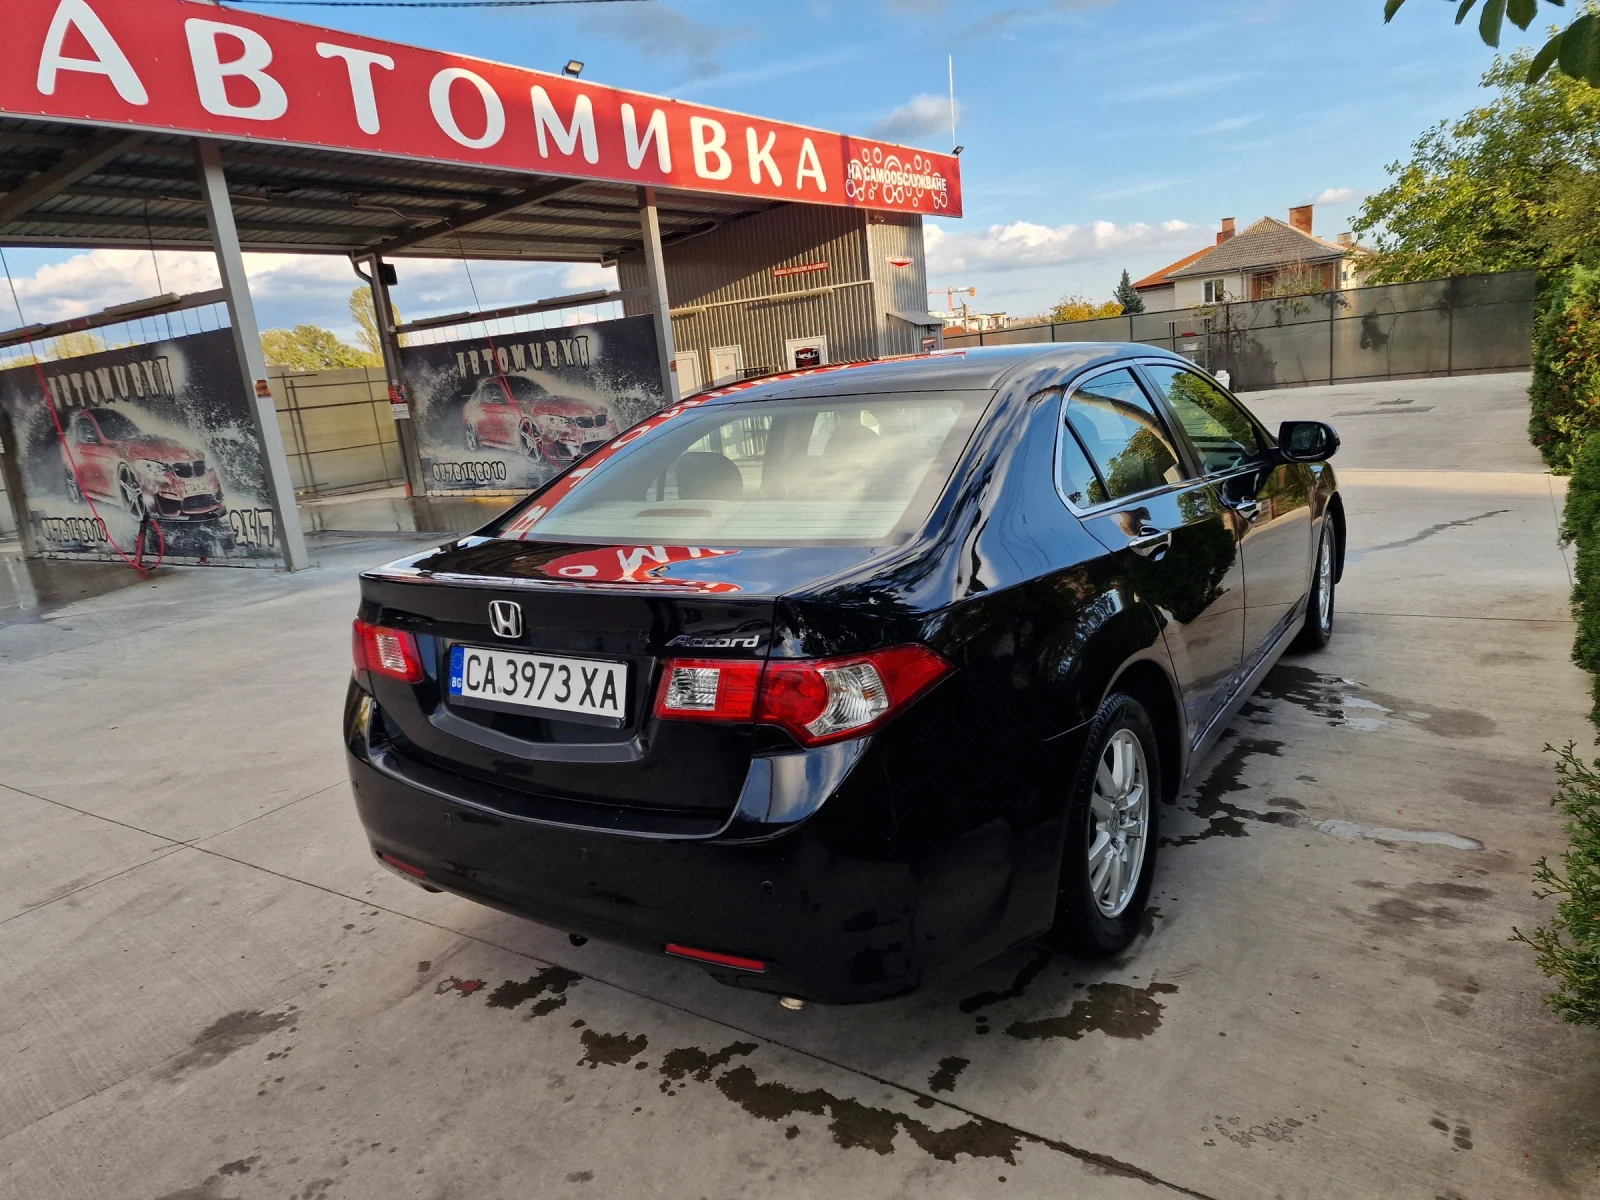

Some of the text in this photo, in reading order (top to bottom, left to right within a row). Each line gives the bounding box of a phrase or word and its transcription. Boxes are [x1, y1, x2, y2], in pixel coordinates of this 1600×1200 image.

[36, 0, 828, 194] АВТОМИВКА
[847, 163, 947, 192] НА САМООБСЛУЖВАНЕ
[229, 507, 275, 547] 24/7
[665, 634, 760, 648] Accord
[451, 676, 463, 688] BG
[466, 654, 618, 710] CA 3973 XA
